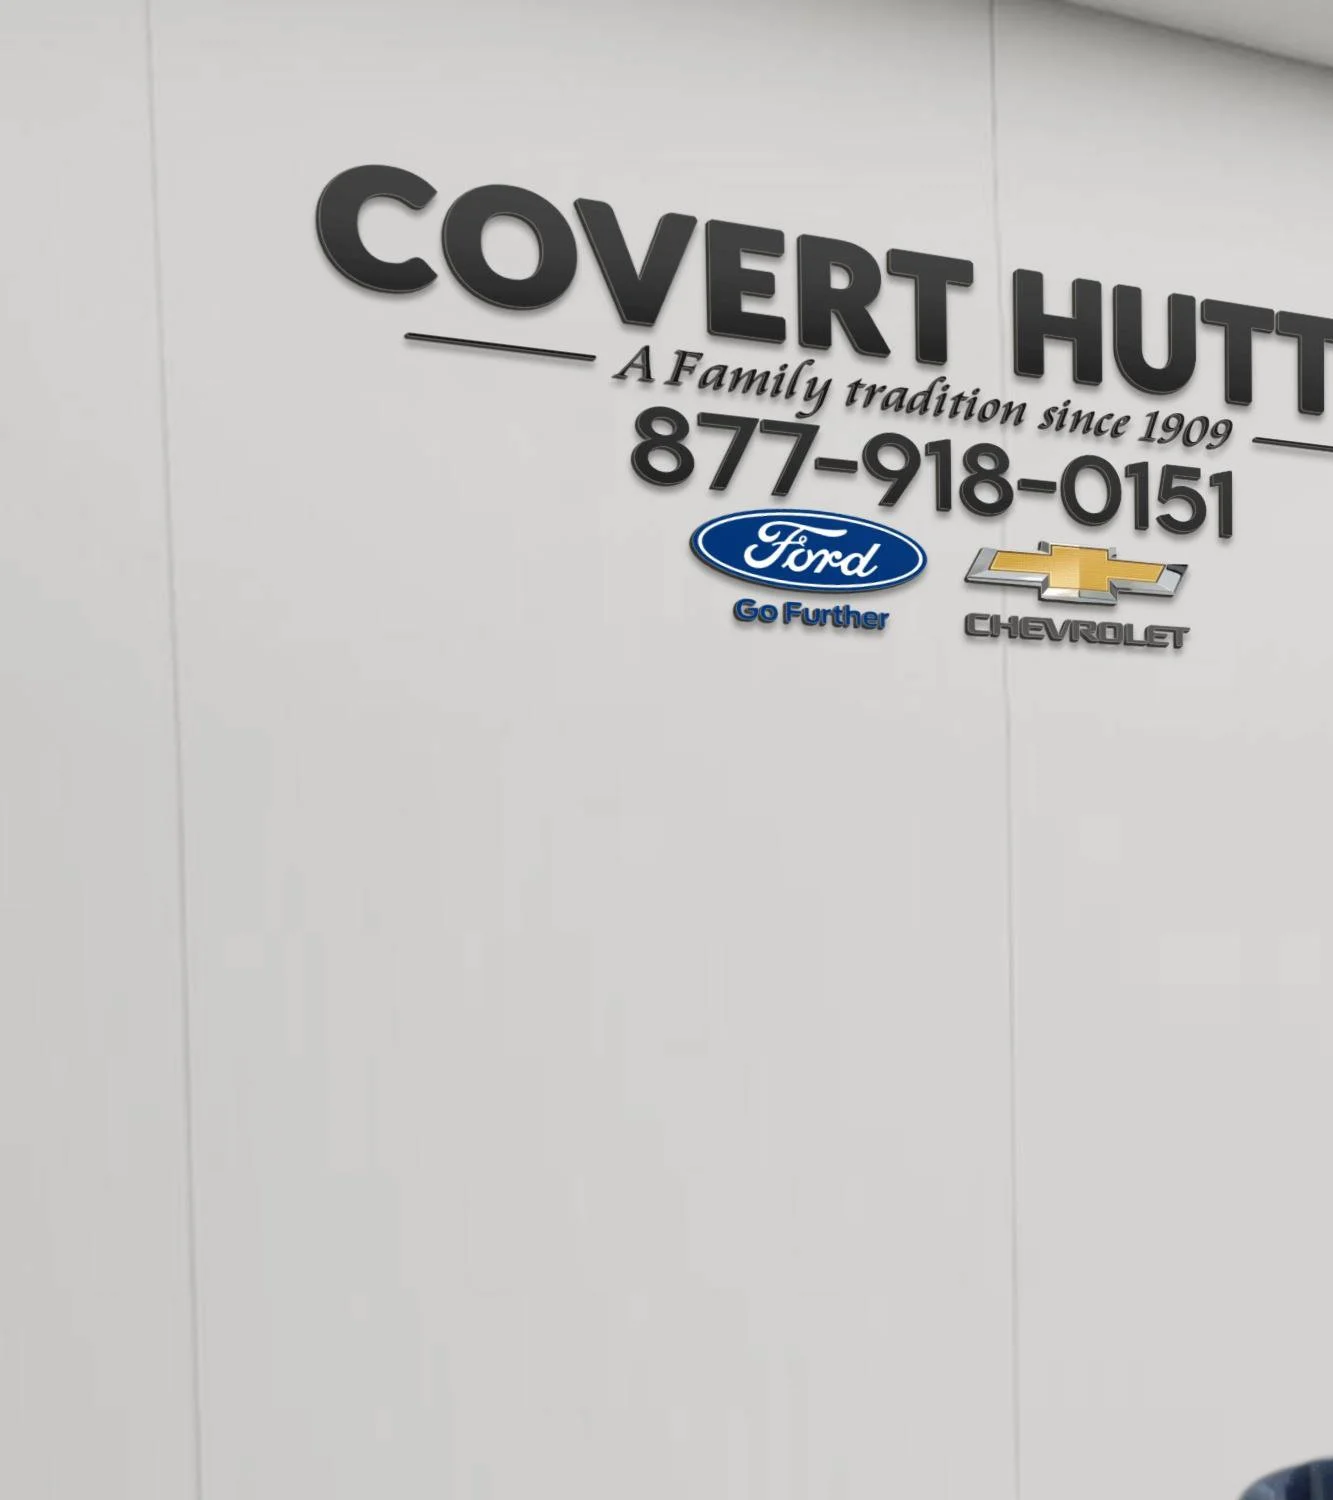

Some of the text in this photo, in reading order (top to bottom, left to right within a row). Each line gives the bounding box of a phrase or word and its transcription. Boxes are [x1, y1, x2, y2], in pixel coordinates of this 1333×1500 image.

[315, 164, 974, 367] COVERT
[612, 344, 1234, 450] A Family tradition since 1909
[630, 406, 1234, 540] 877-918-0151
[743, 520, 879, 579] Ford
[732, 598, 890, 631] Go Further
[964, 612, 1190, 650] CHEVROLET
